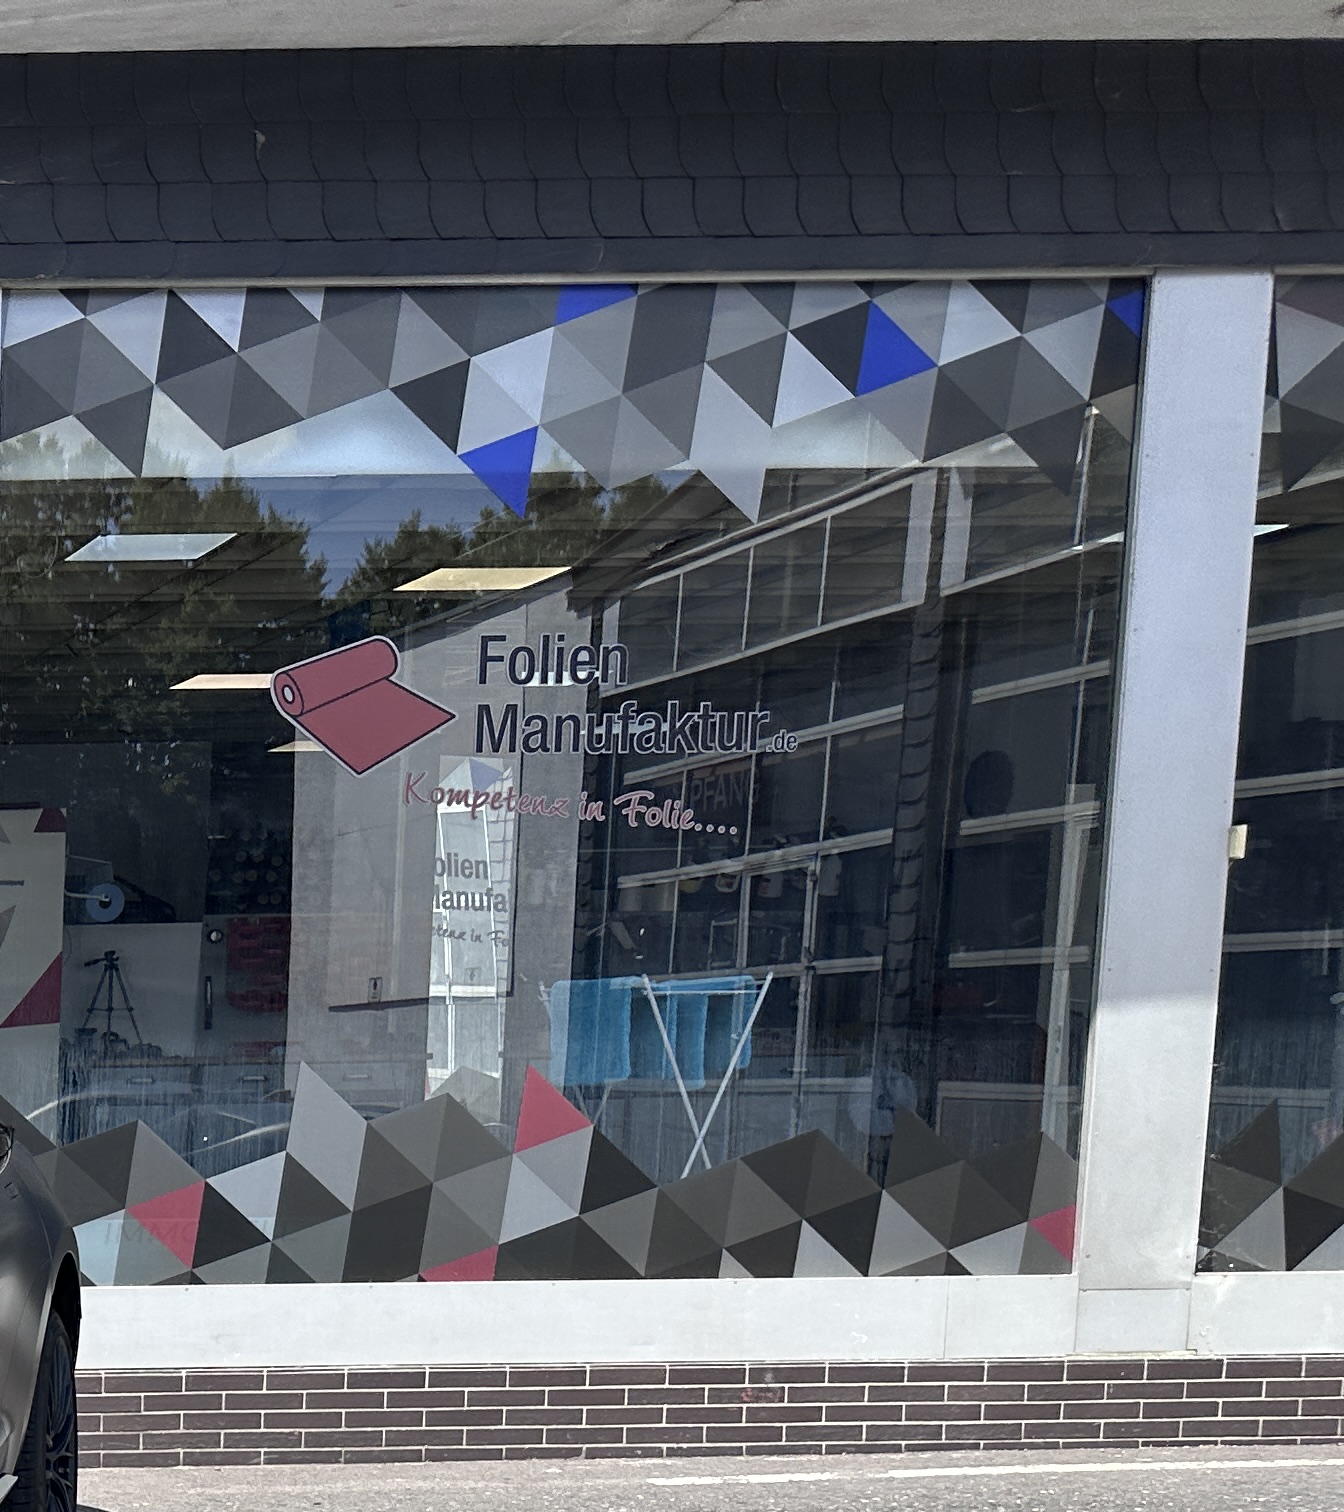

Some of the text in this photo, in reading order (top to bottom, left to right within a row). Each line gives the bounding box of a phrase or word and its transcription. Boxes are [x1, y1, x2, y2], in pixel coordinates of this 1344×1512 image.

[476, 632, 629, 686] Folien
[474, 700, 799, 755] Manufaktur.de
[404, 771, 569, 821] Kompetenz
[578, 791, 606, 822] in
